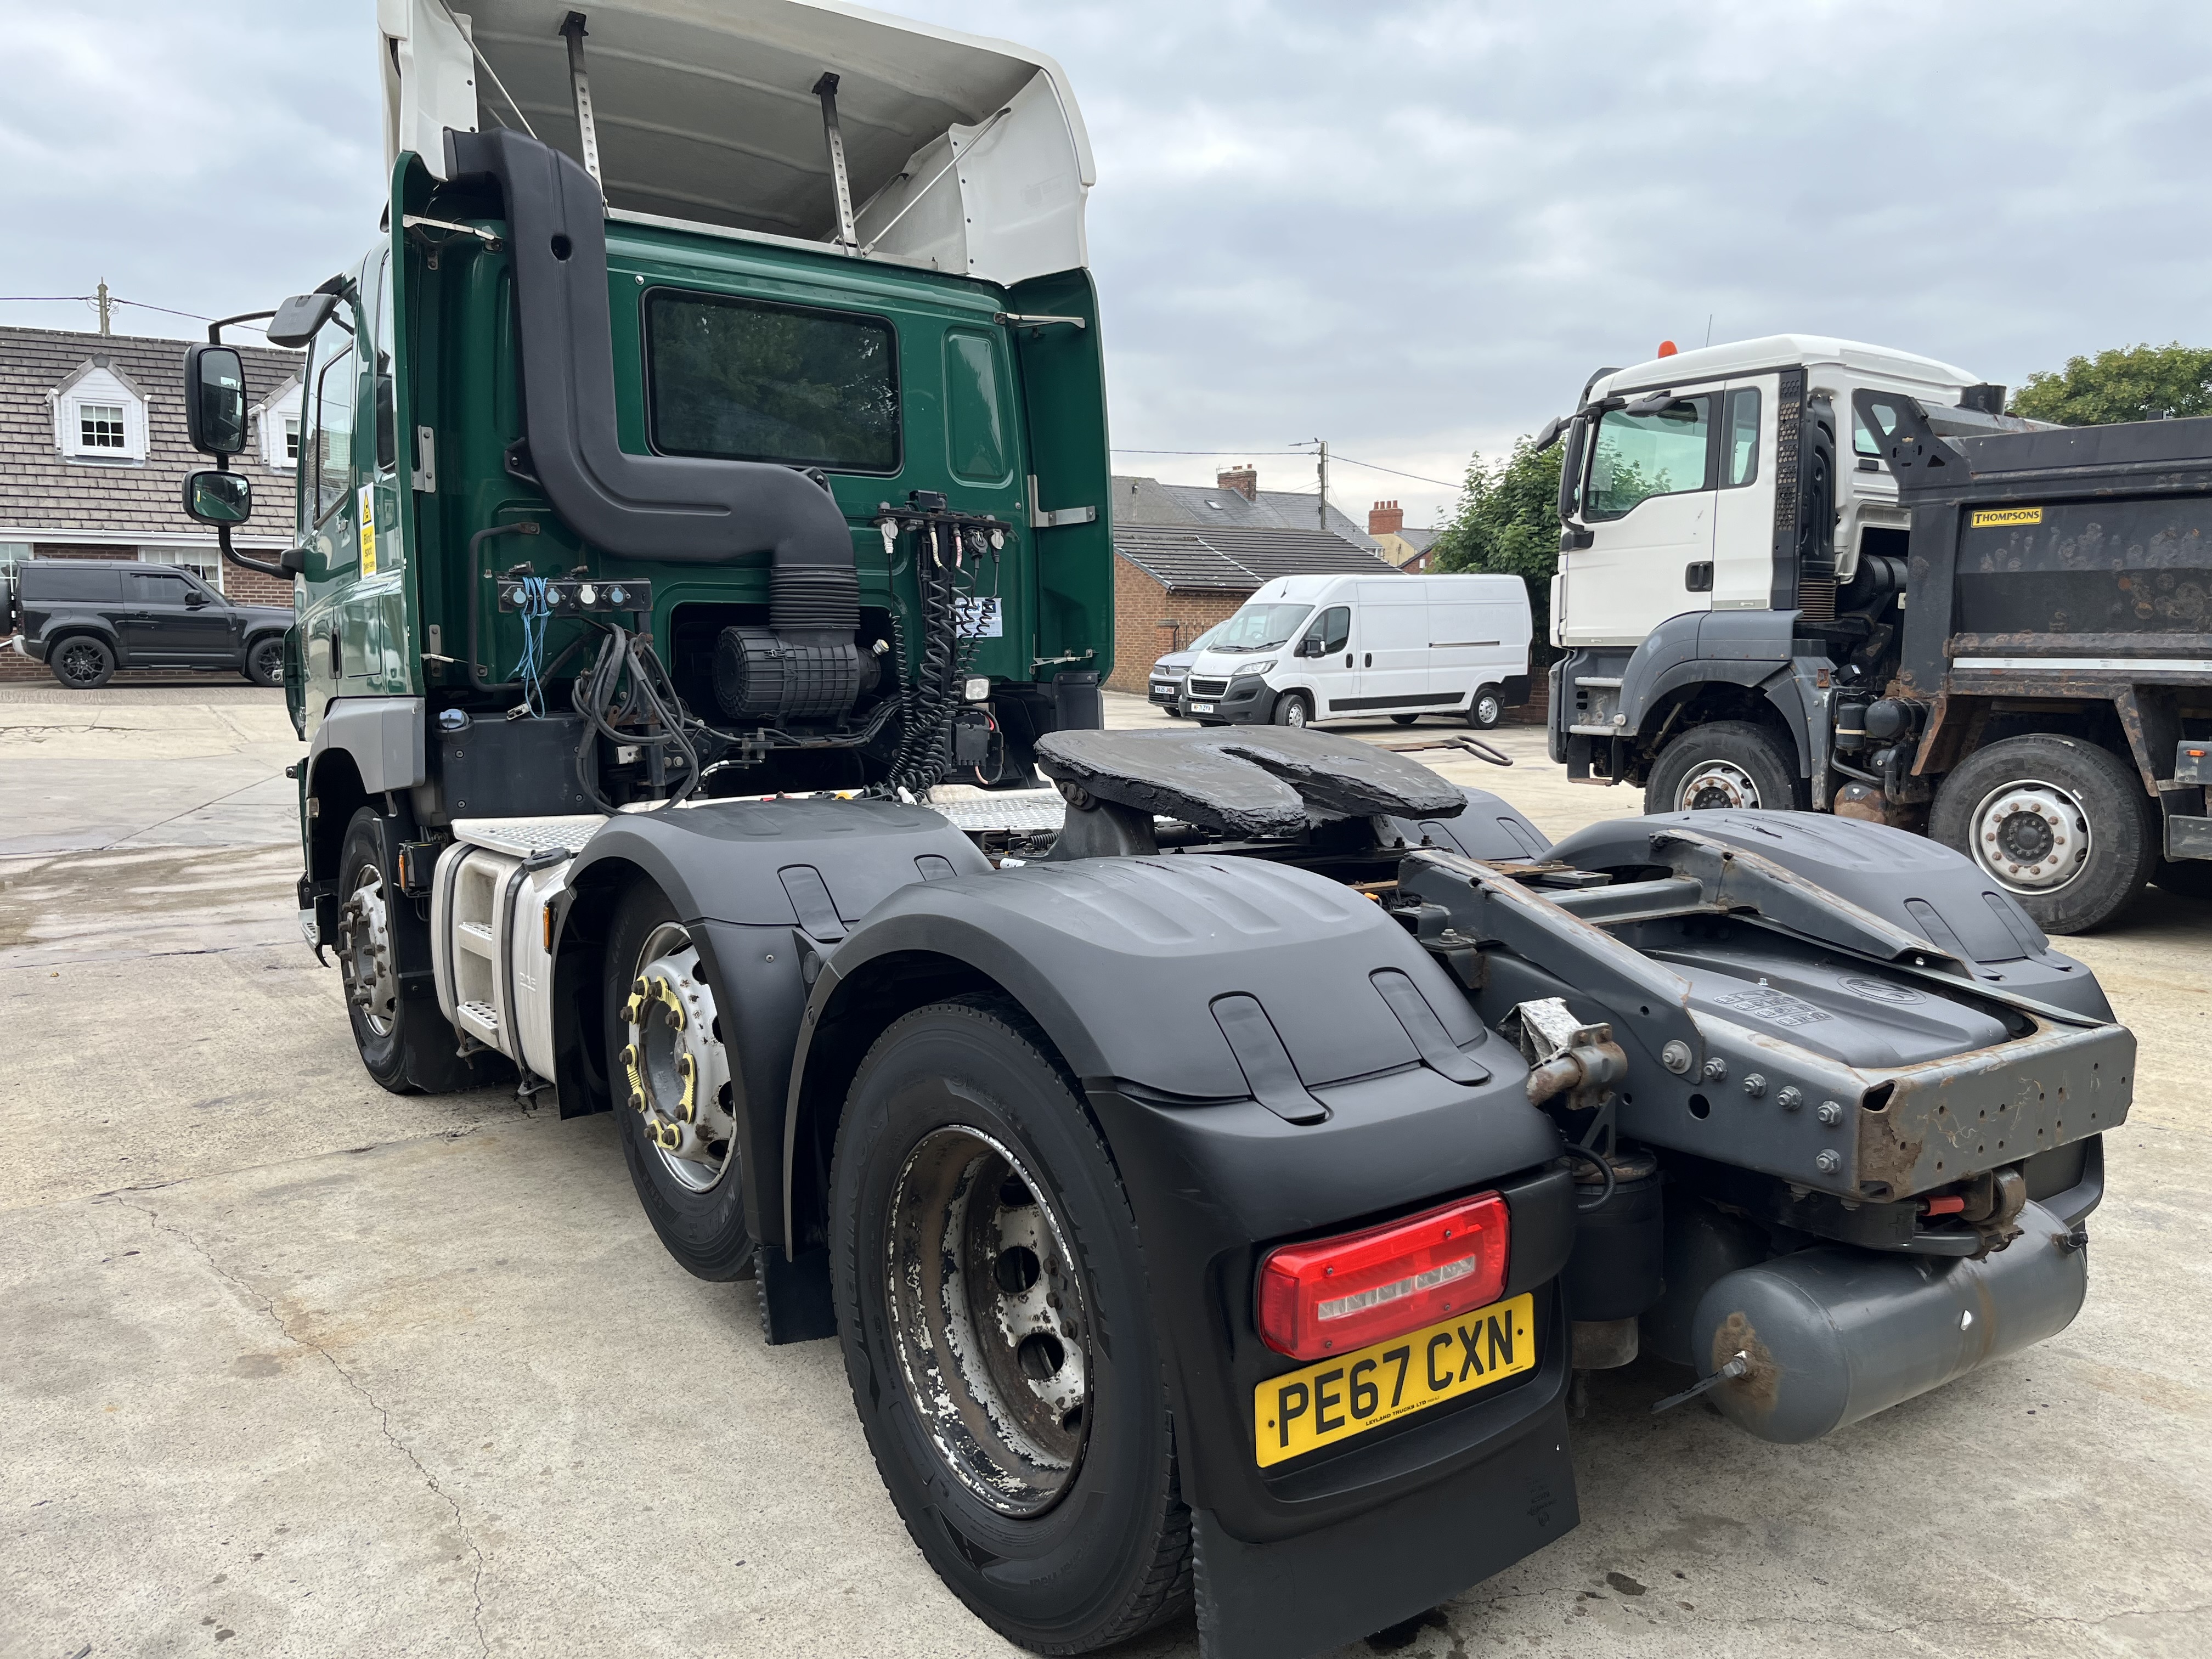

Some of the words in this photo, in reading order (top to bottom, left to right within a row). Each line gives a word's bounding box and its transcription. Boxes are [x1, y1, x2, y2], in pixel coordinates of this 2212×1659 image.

[1974, 511, 2040, 524] THOMPSONS
[364, 531, 372, 545] Blind
[1278, 1345, 1410, 1448] PE67
[1427, 1310, 1514, 1391] CXN
[1365, 1413, 1391, 1426] LEYLAND
[1392, 1404, 1415, 1416] TRUCKS
